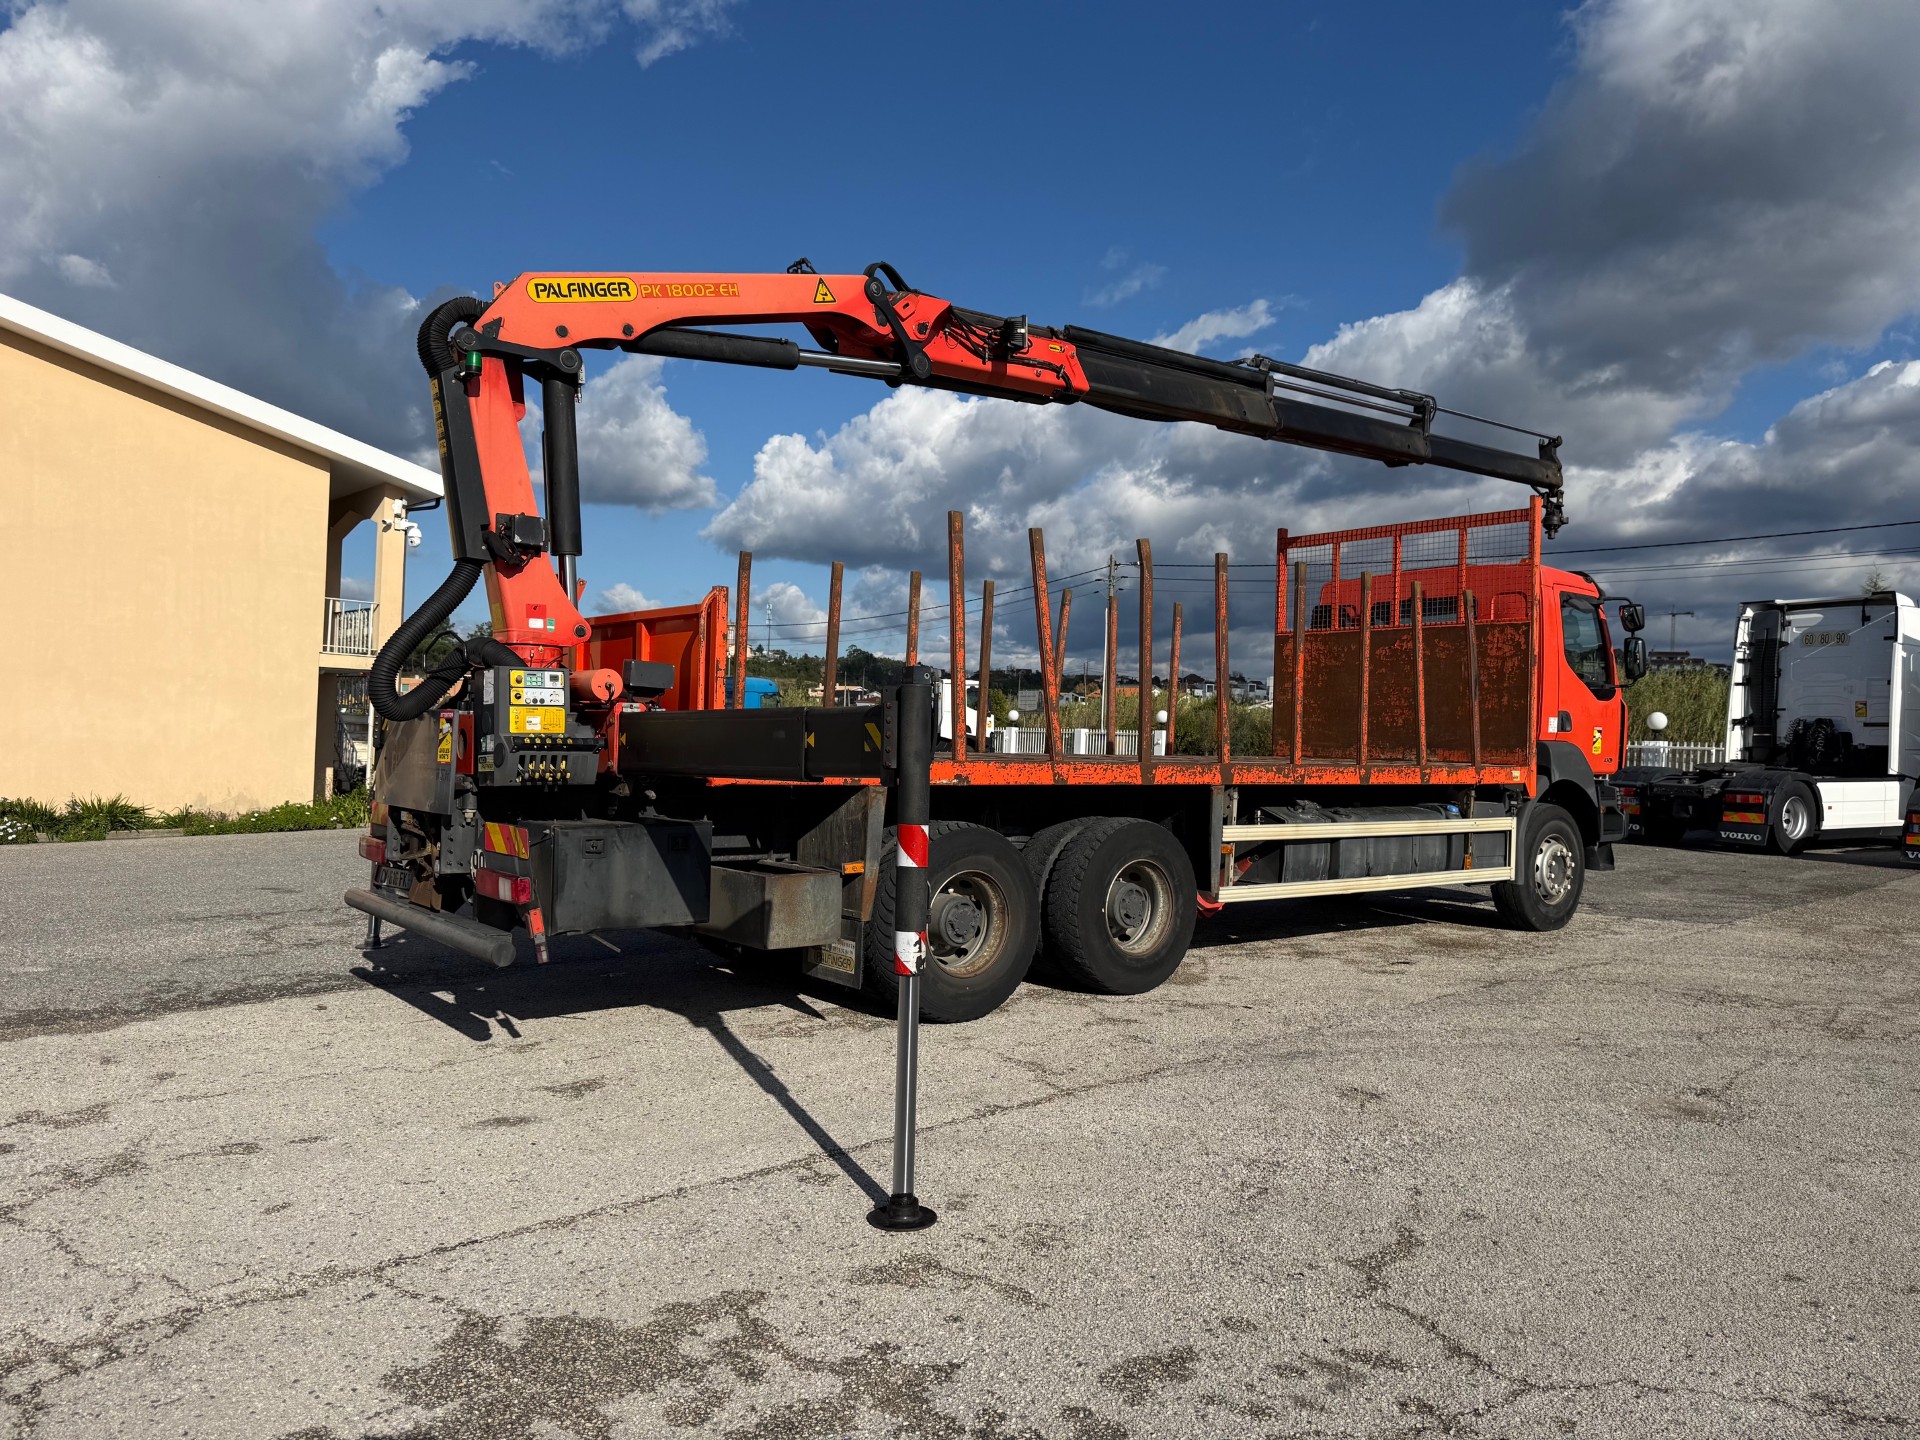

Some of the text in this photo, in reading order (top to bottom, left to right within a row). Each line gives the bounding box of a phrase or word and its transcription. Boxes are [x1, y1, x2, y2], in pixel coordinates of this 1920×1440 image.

[534, 282, 631, 299] PALFINGER
[641, 284, 662, 298] PK
[1804, 632, 1846, 645] 60 80 90
[1719, 830, 1762, 841] VOLVO
